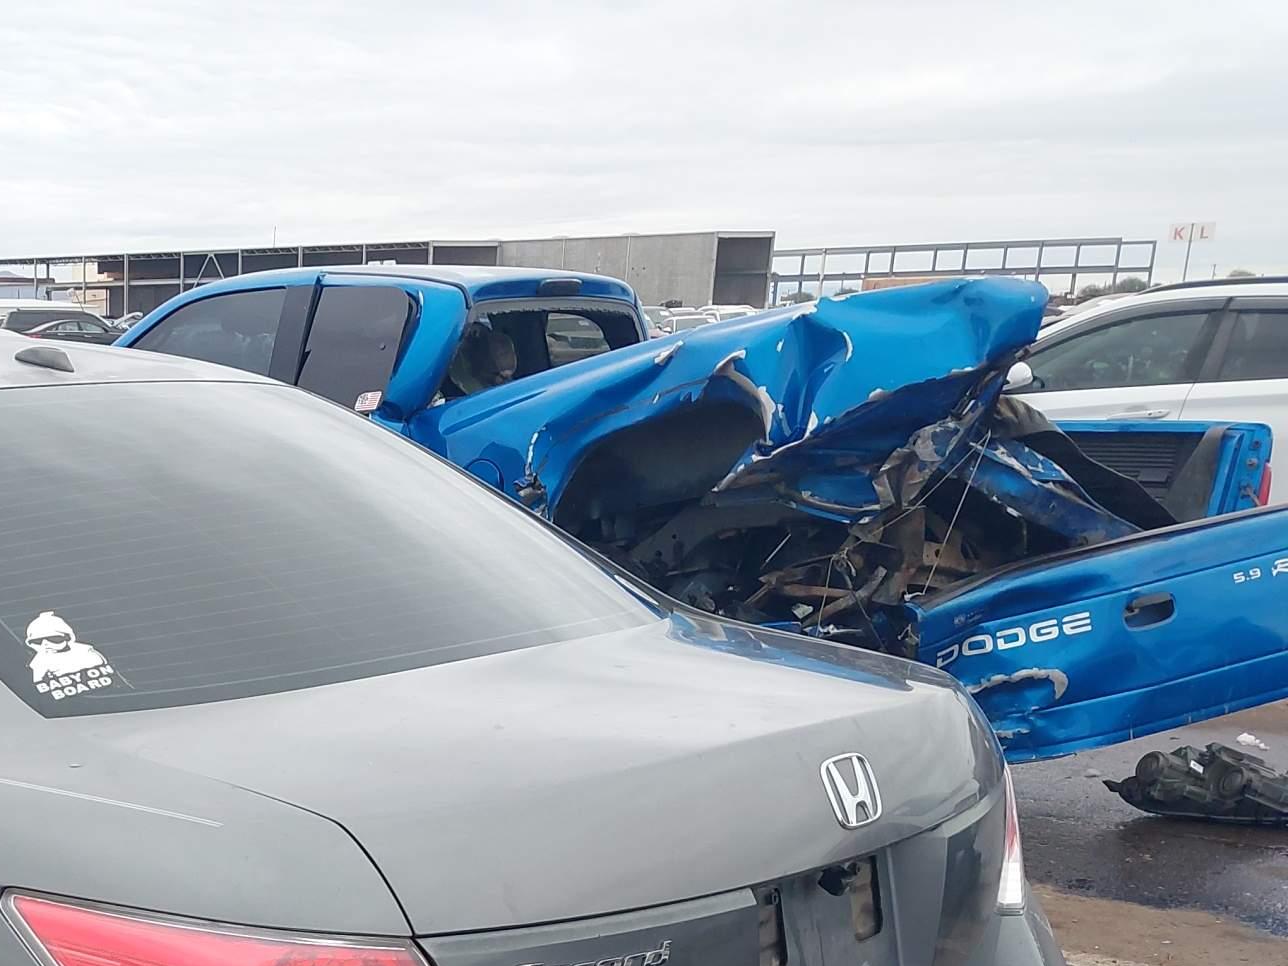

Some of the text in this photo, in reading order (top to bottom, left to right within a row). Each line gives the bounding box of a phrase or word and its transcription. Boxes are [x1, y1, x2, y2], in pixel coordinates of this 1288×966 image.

[1174, 225, 1209, 241] K L
[1233, 567, 1262, 584] 5.9
[936, 611, 1092, 668] DODGE
[36, 664, 114, 694] BABY ON
[51, 676, 113, 701] BOARD
